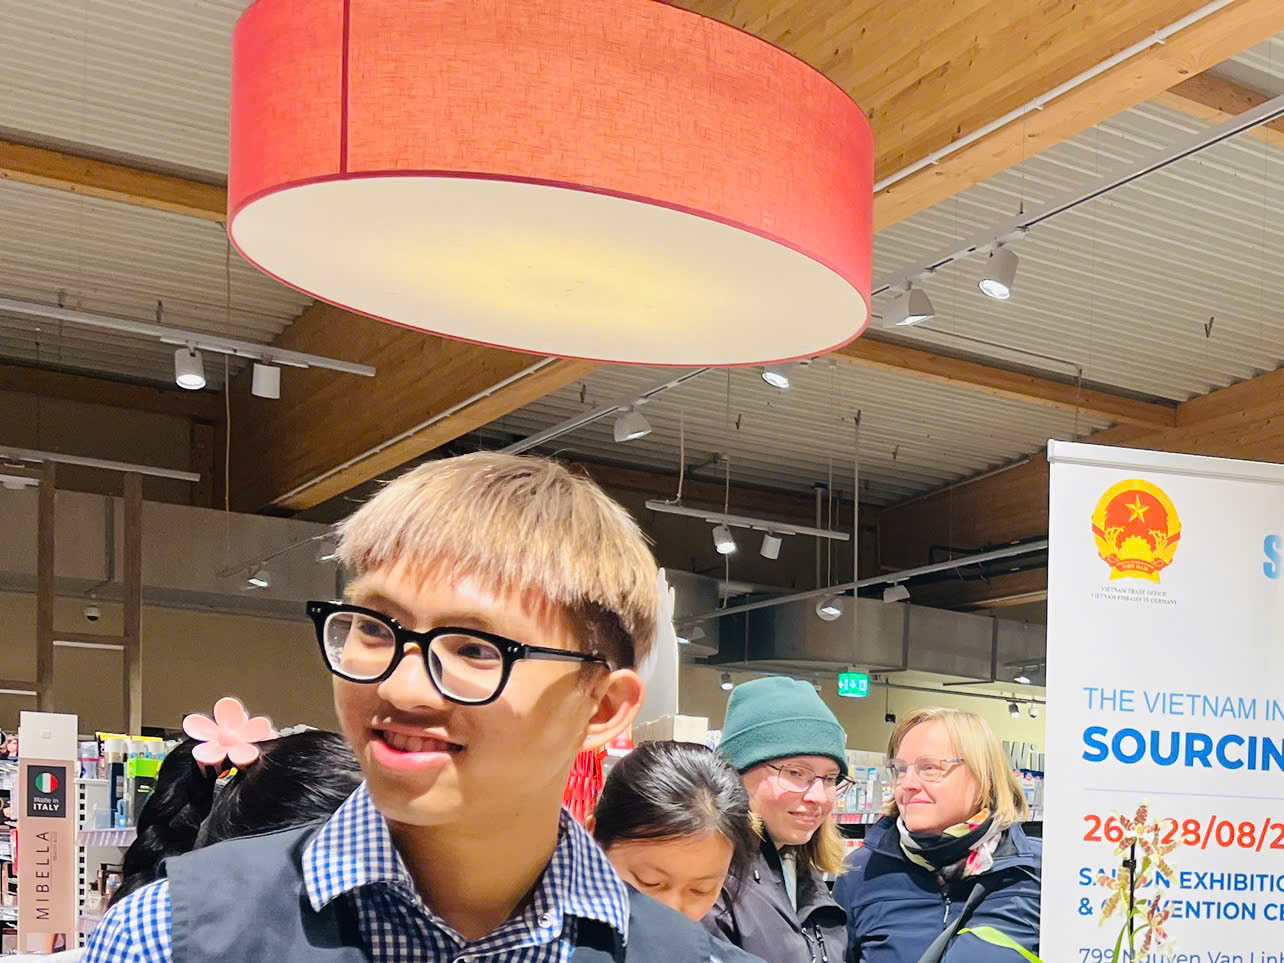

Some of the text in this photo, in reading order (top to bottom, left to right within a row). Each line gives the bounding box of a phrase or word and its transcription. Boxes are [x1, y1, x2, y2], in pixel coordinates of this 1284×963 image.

[1082, 687, 1135, 713] THE
[1143, 690, 1257, 721] VIETNAM
[33, 803, 60, 812] ITALY
[35, 831, 50, 920] MIBELLA
[1078, 896, 1094, 916] &
